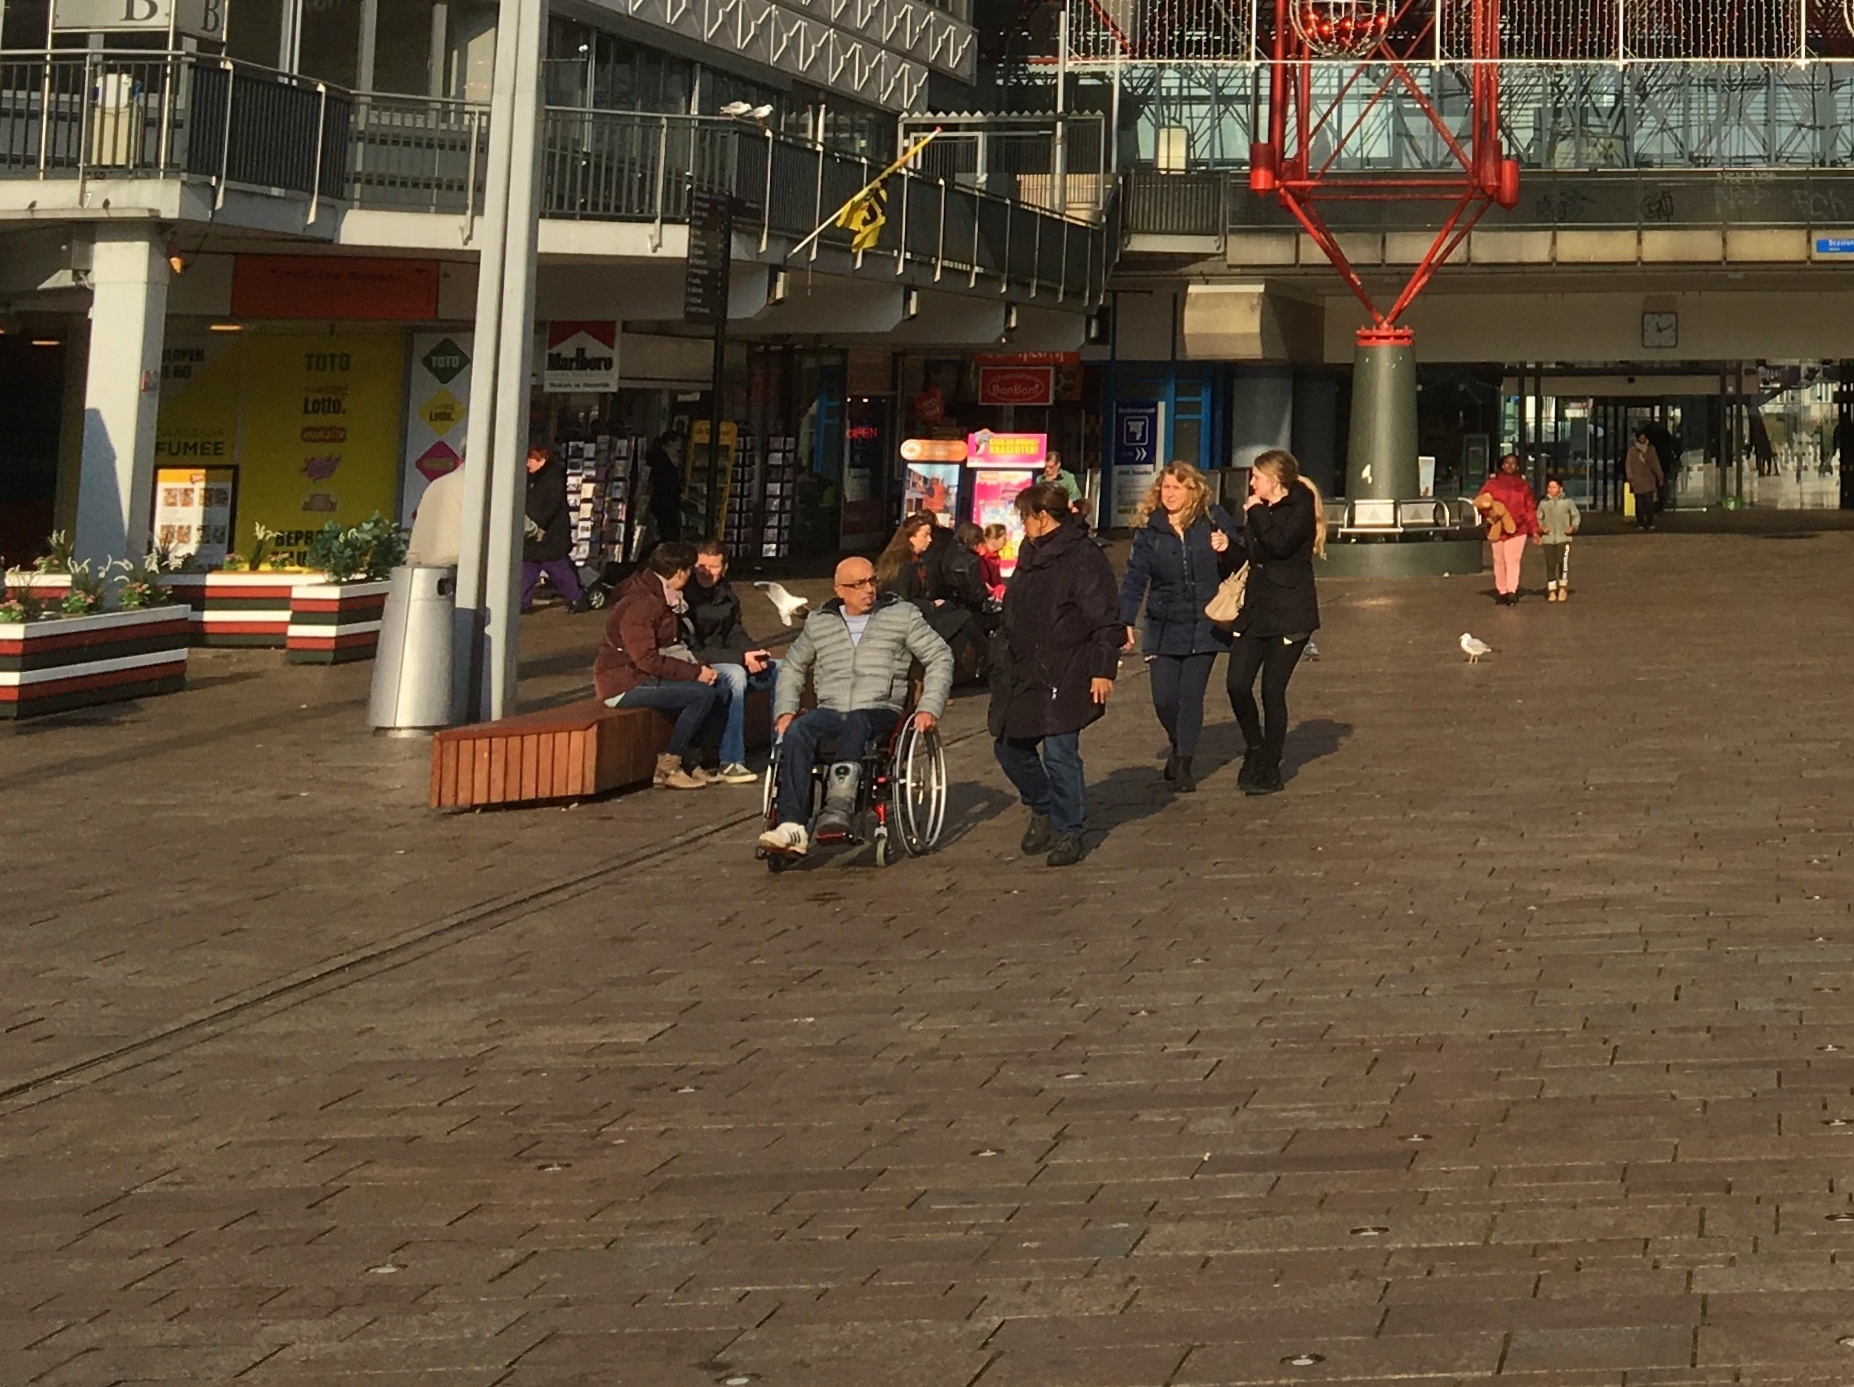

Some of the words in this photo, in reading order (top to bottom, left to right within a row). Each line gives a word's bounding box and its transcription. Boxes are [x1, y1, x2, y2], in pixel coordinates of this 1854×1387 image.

[304, 352, 351, 372] TOTO
[431, 355, 460, 369] TOTO
[546, 347, 613, 371] Marlboro
[846, 426, 878, 439] OPEN
